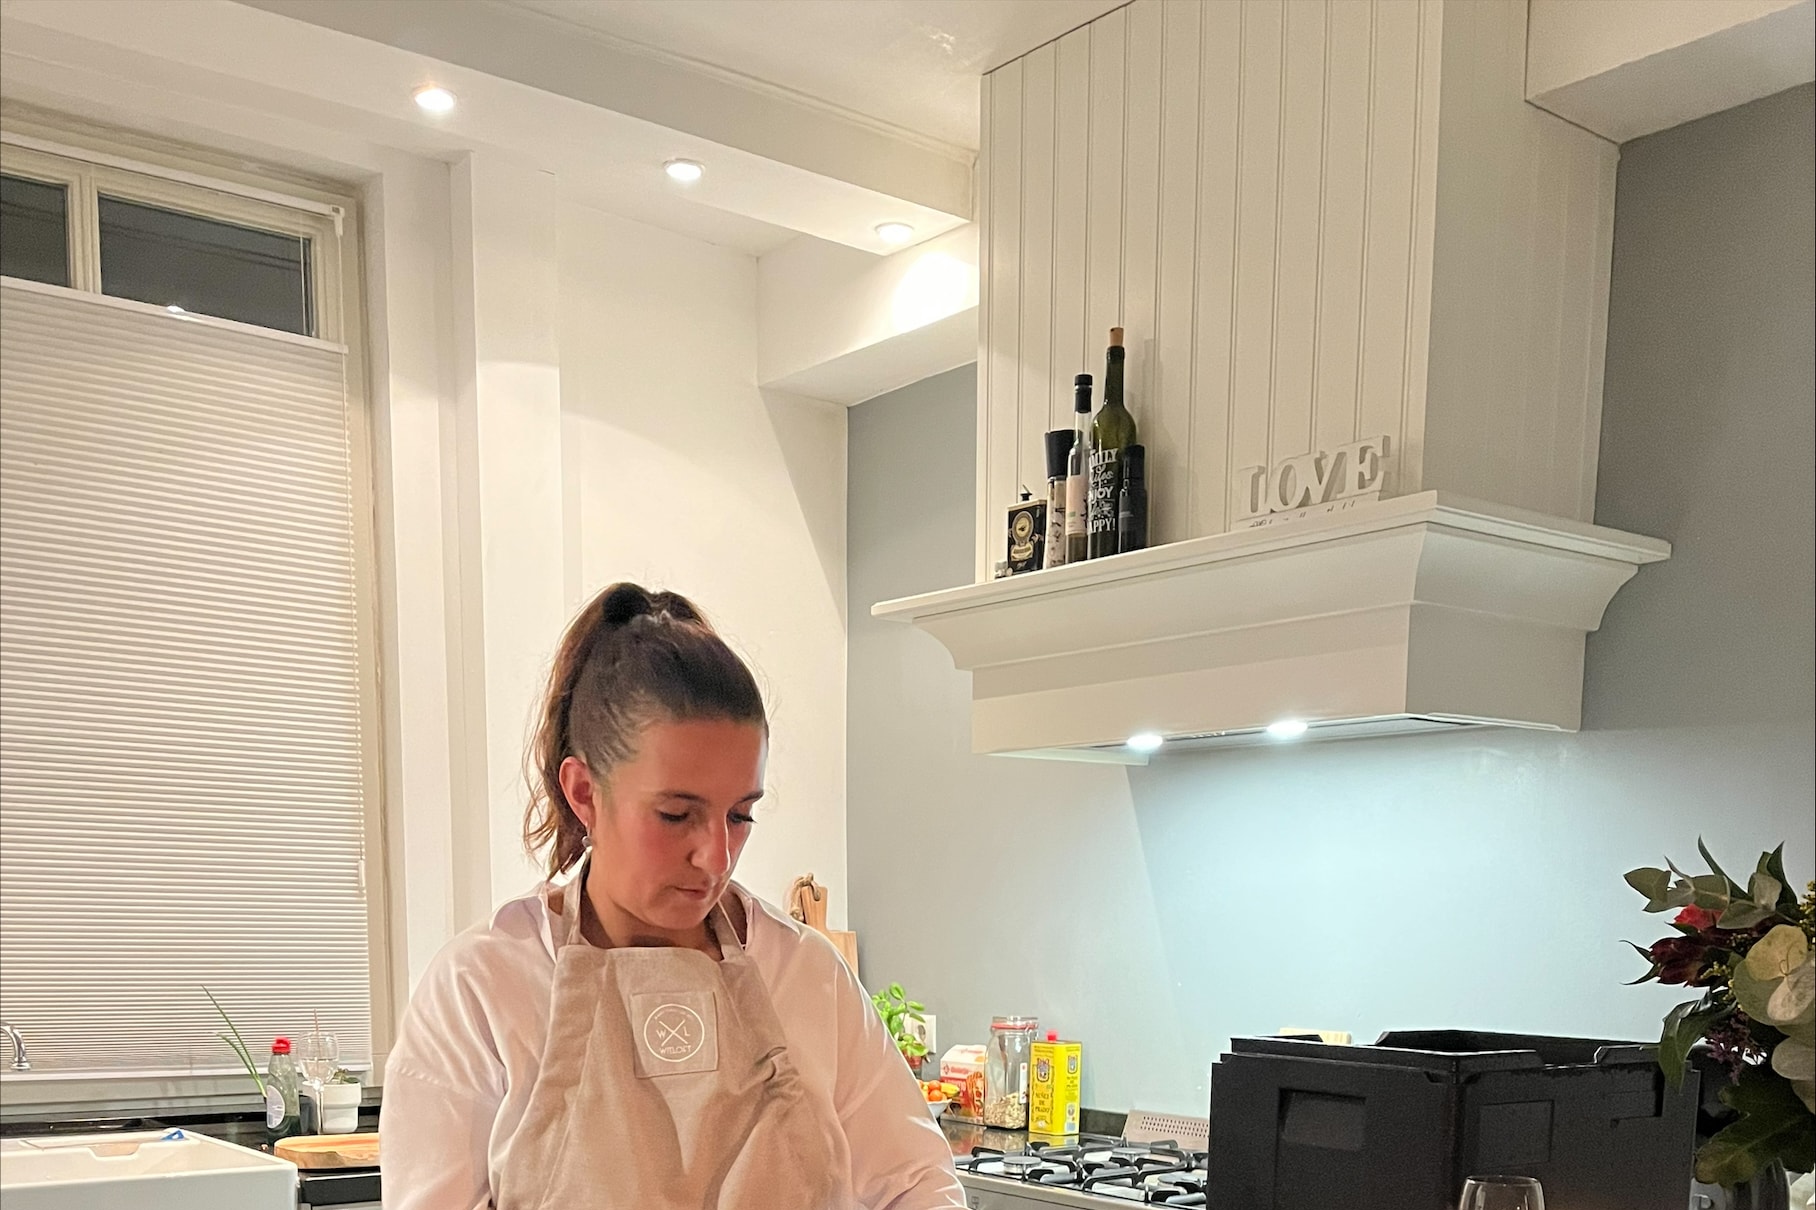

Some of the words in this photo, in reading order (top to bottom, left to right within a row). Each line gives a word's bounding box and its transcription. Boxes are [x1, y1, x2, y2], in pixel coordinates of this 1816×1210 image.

[1238, 435, 1391, 517] LOVE
[656, 1029, 667, 1040] W
[683, 1026, 691, 1037] L
